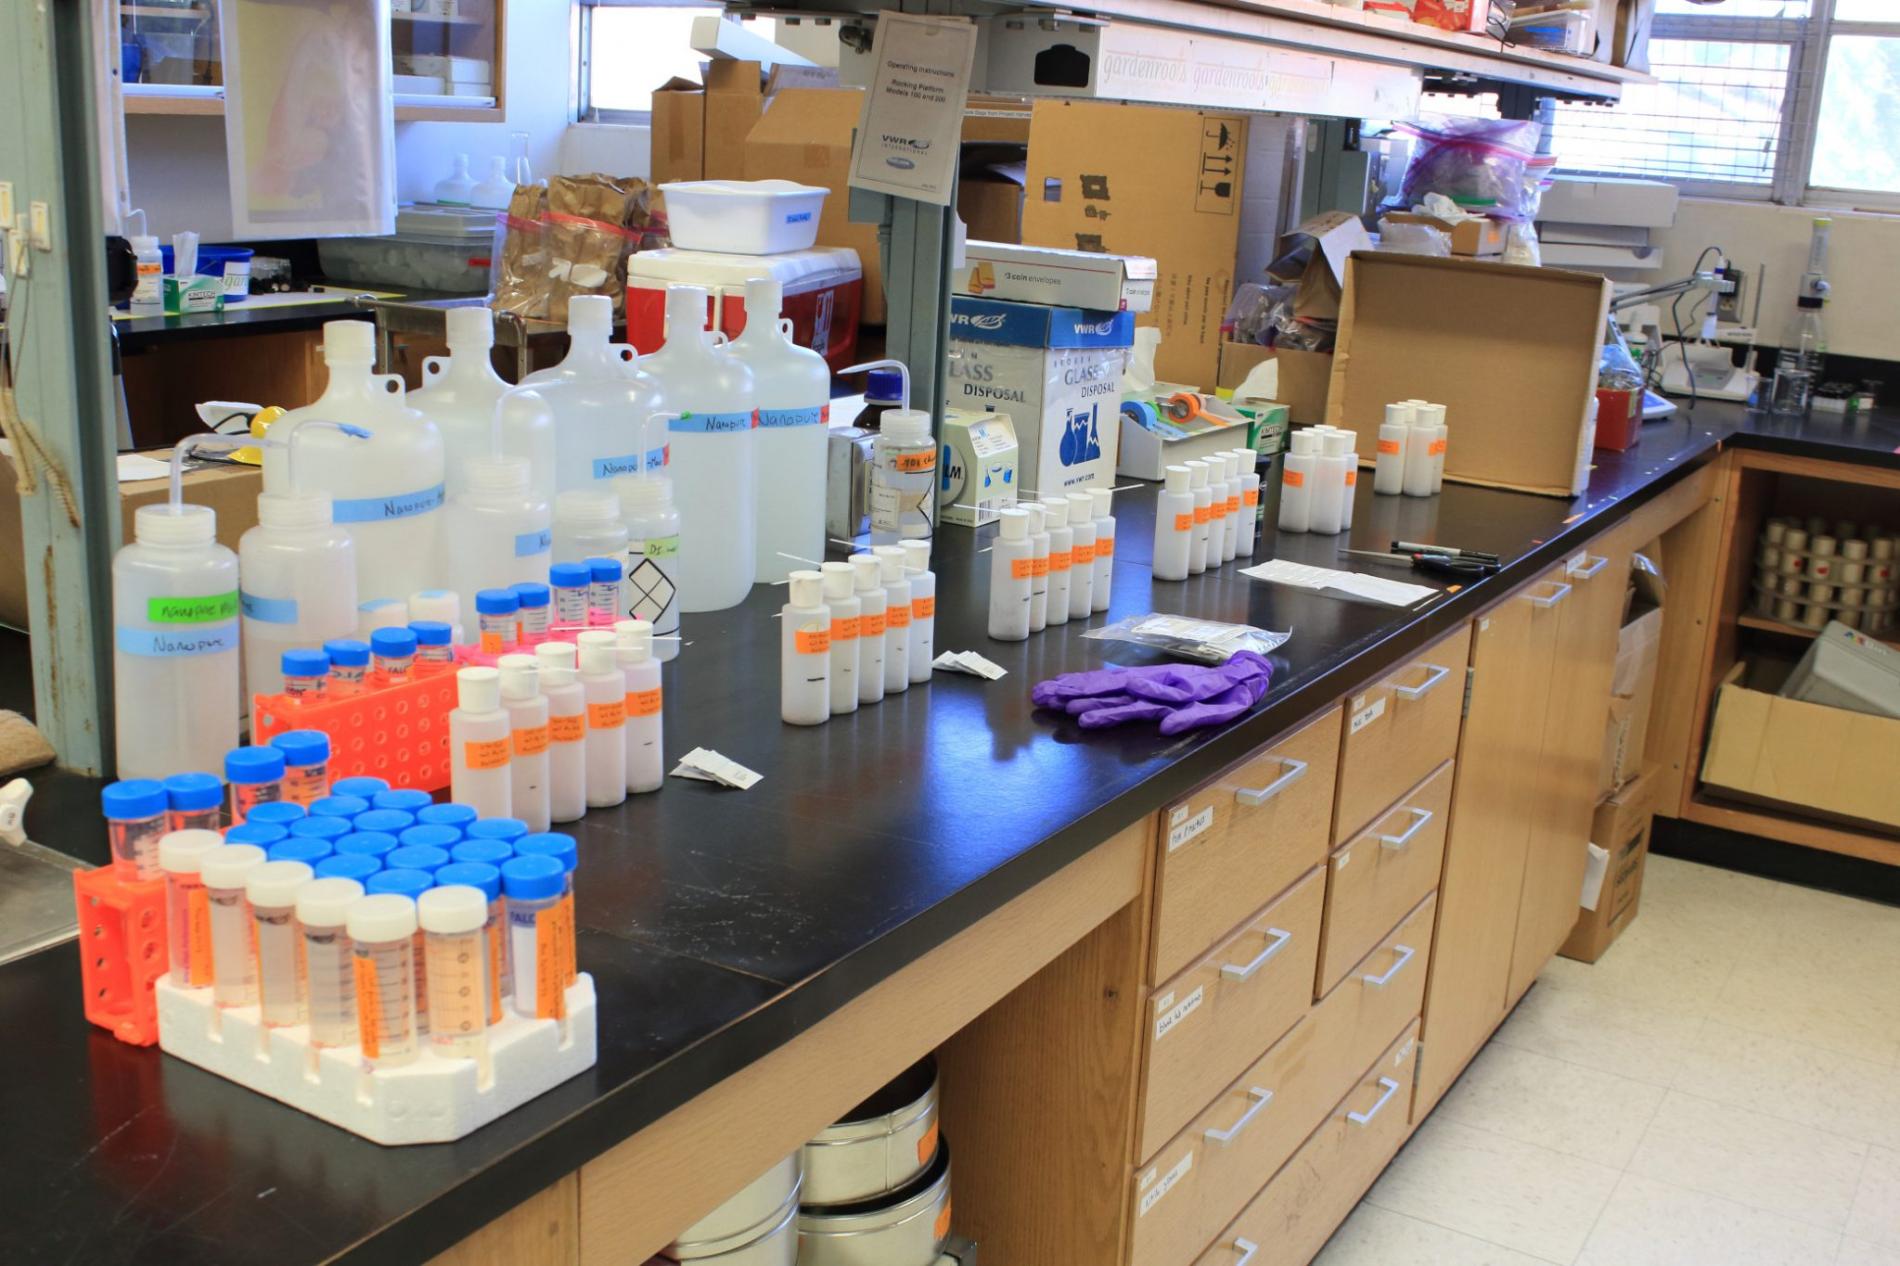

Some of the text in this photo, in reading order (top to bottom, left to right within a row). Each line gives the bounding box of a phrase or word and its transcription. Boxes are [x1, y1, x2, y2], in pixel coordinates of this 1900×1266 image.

[887, 60, 918, 73] Operating
[886, 87, 908, 98] Models
[922, 93, 933, 102] and
[882, 134, 909, 145] VWR
[1012, 273, 1028, 281] coin
[1028, 274, 1061, 286] envelopes
[1074, 323, 1096, 335] VWR
[950, 361, 994, 382] LASS
[963, 383, 1026, 403] DISPOSAL
[1081, 381, 1115, 398] DISPOSAL
[1063, 472, 1095, 487] www.vwr.com
